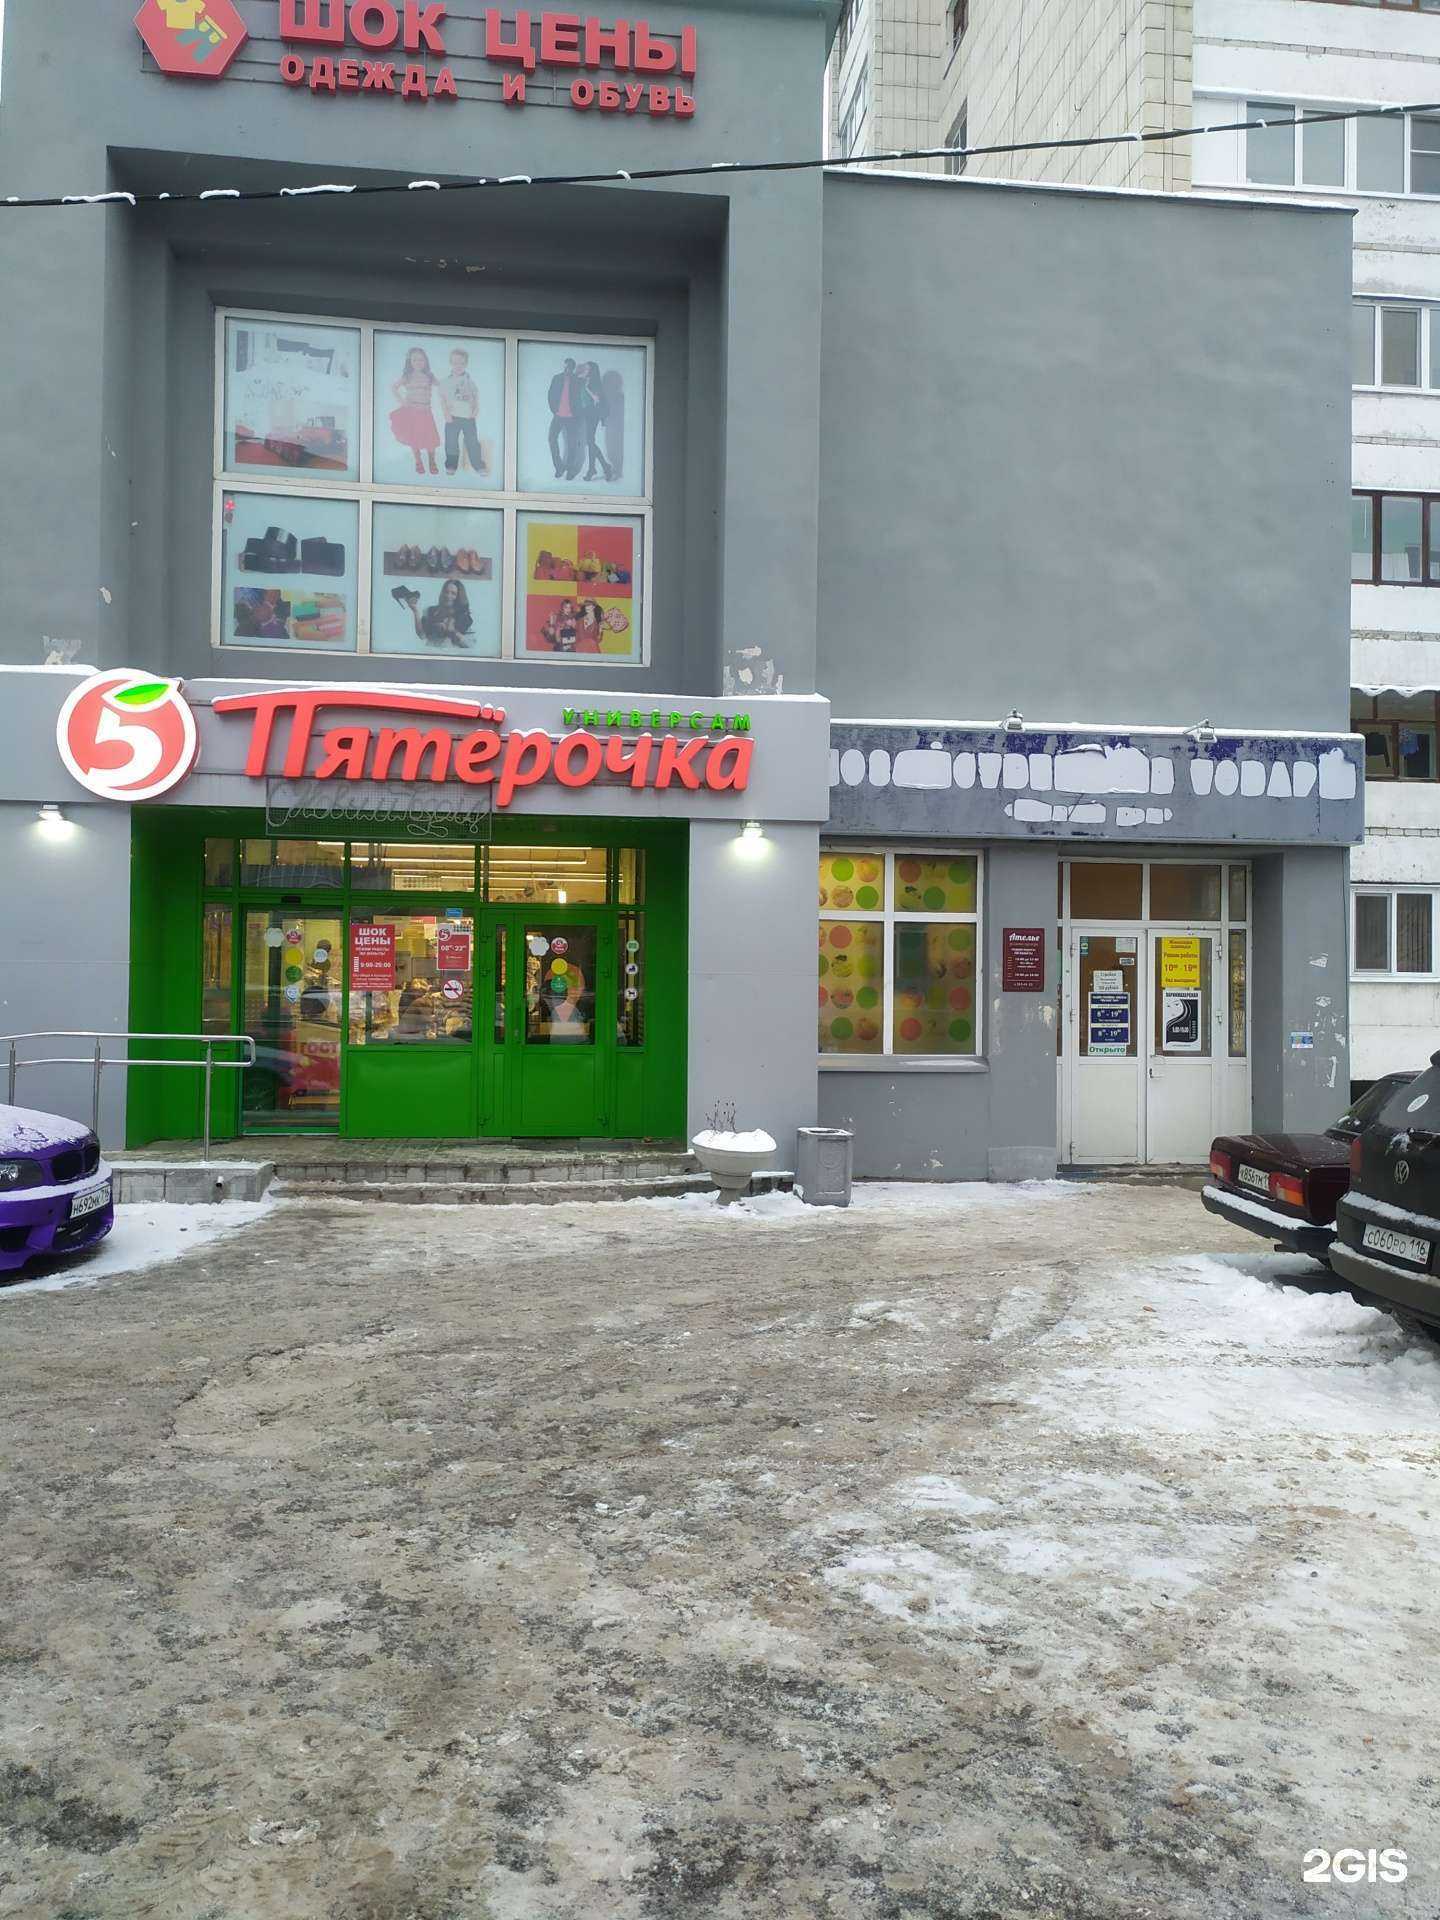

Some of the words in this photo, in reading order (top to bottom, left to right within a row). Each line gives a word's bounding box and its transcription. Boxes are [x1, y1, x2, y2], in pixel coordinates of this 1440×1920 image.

[279, 0, 447, 55] ШОК
[485, 8, 698, 78] ЦЕНЫ
[279, 54, 458, 105] ОДЕЖДА
[502, 72, 527, 105] И
[570, 78, 697, 116] ОБУВЬ
[561, 707, 751, 732] УНИВЕРСАМ
[358, 927, 387, 936] ШОК
[354, 936, 391, 946] ЦЕНЫ
[1008, 932, 1041, 942] Ателье
[1089, 1046, 1126, 1054] Открыто
